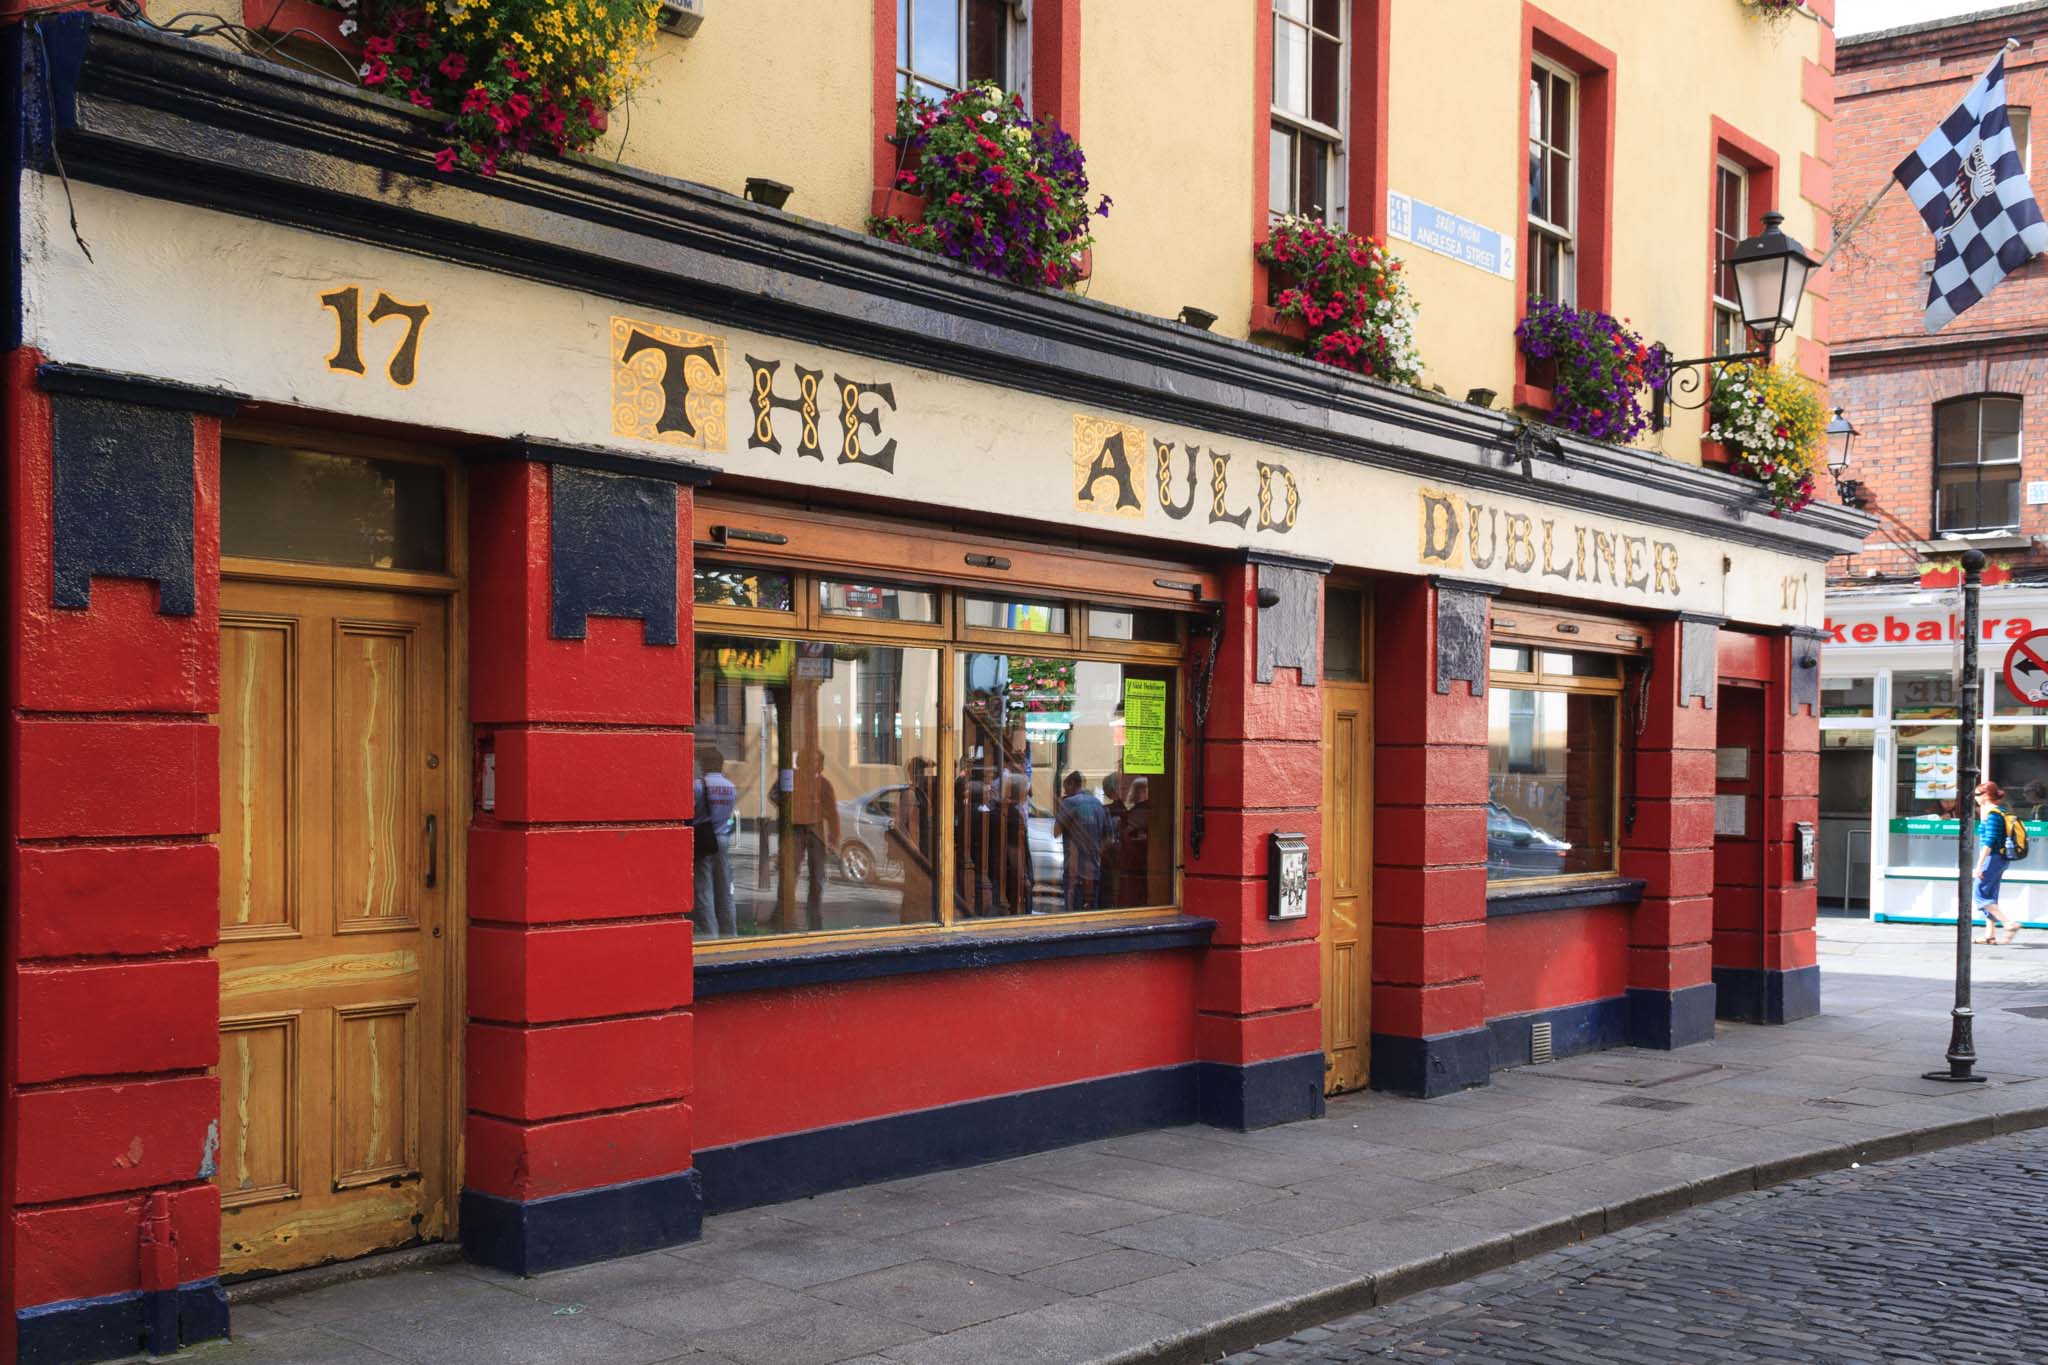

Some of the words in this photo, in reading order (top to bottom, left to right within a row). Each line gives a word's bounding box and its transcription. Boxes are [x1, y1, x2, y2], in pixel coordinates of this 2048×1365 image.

[1416, 227, 1463, 255] ANGLESEA
[1465, 244, 1496, 269] STREET
[1503, 247, 1512, 268] 2
[321, 284, 431, 390] 17
[620, 328, 897, 475] THE
[1077, 430, 1301, 534] AULD
[1422, 494, 1681, 596] DUBLINER
[1779, 574, 1801, 613] 17
